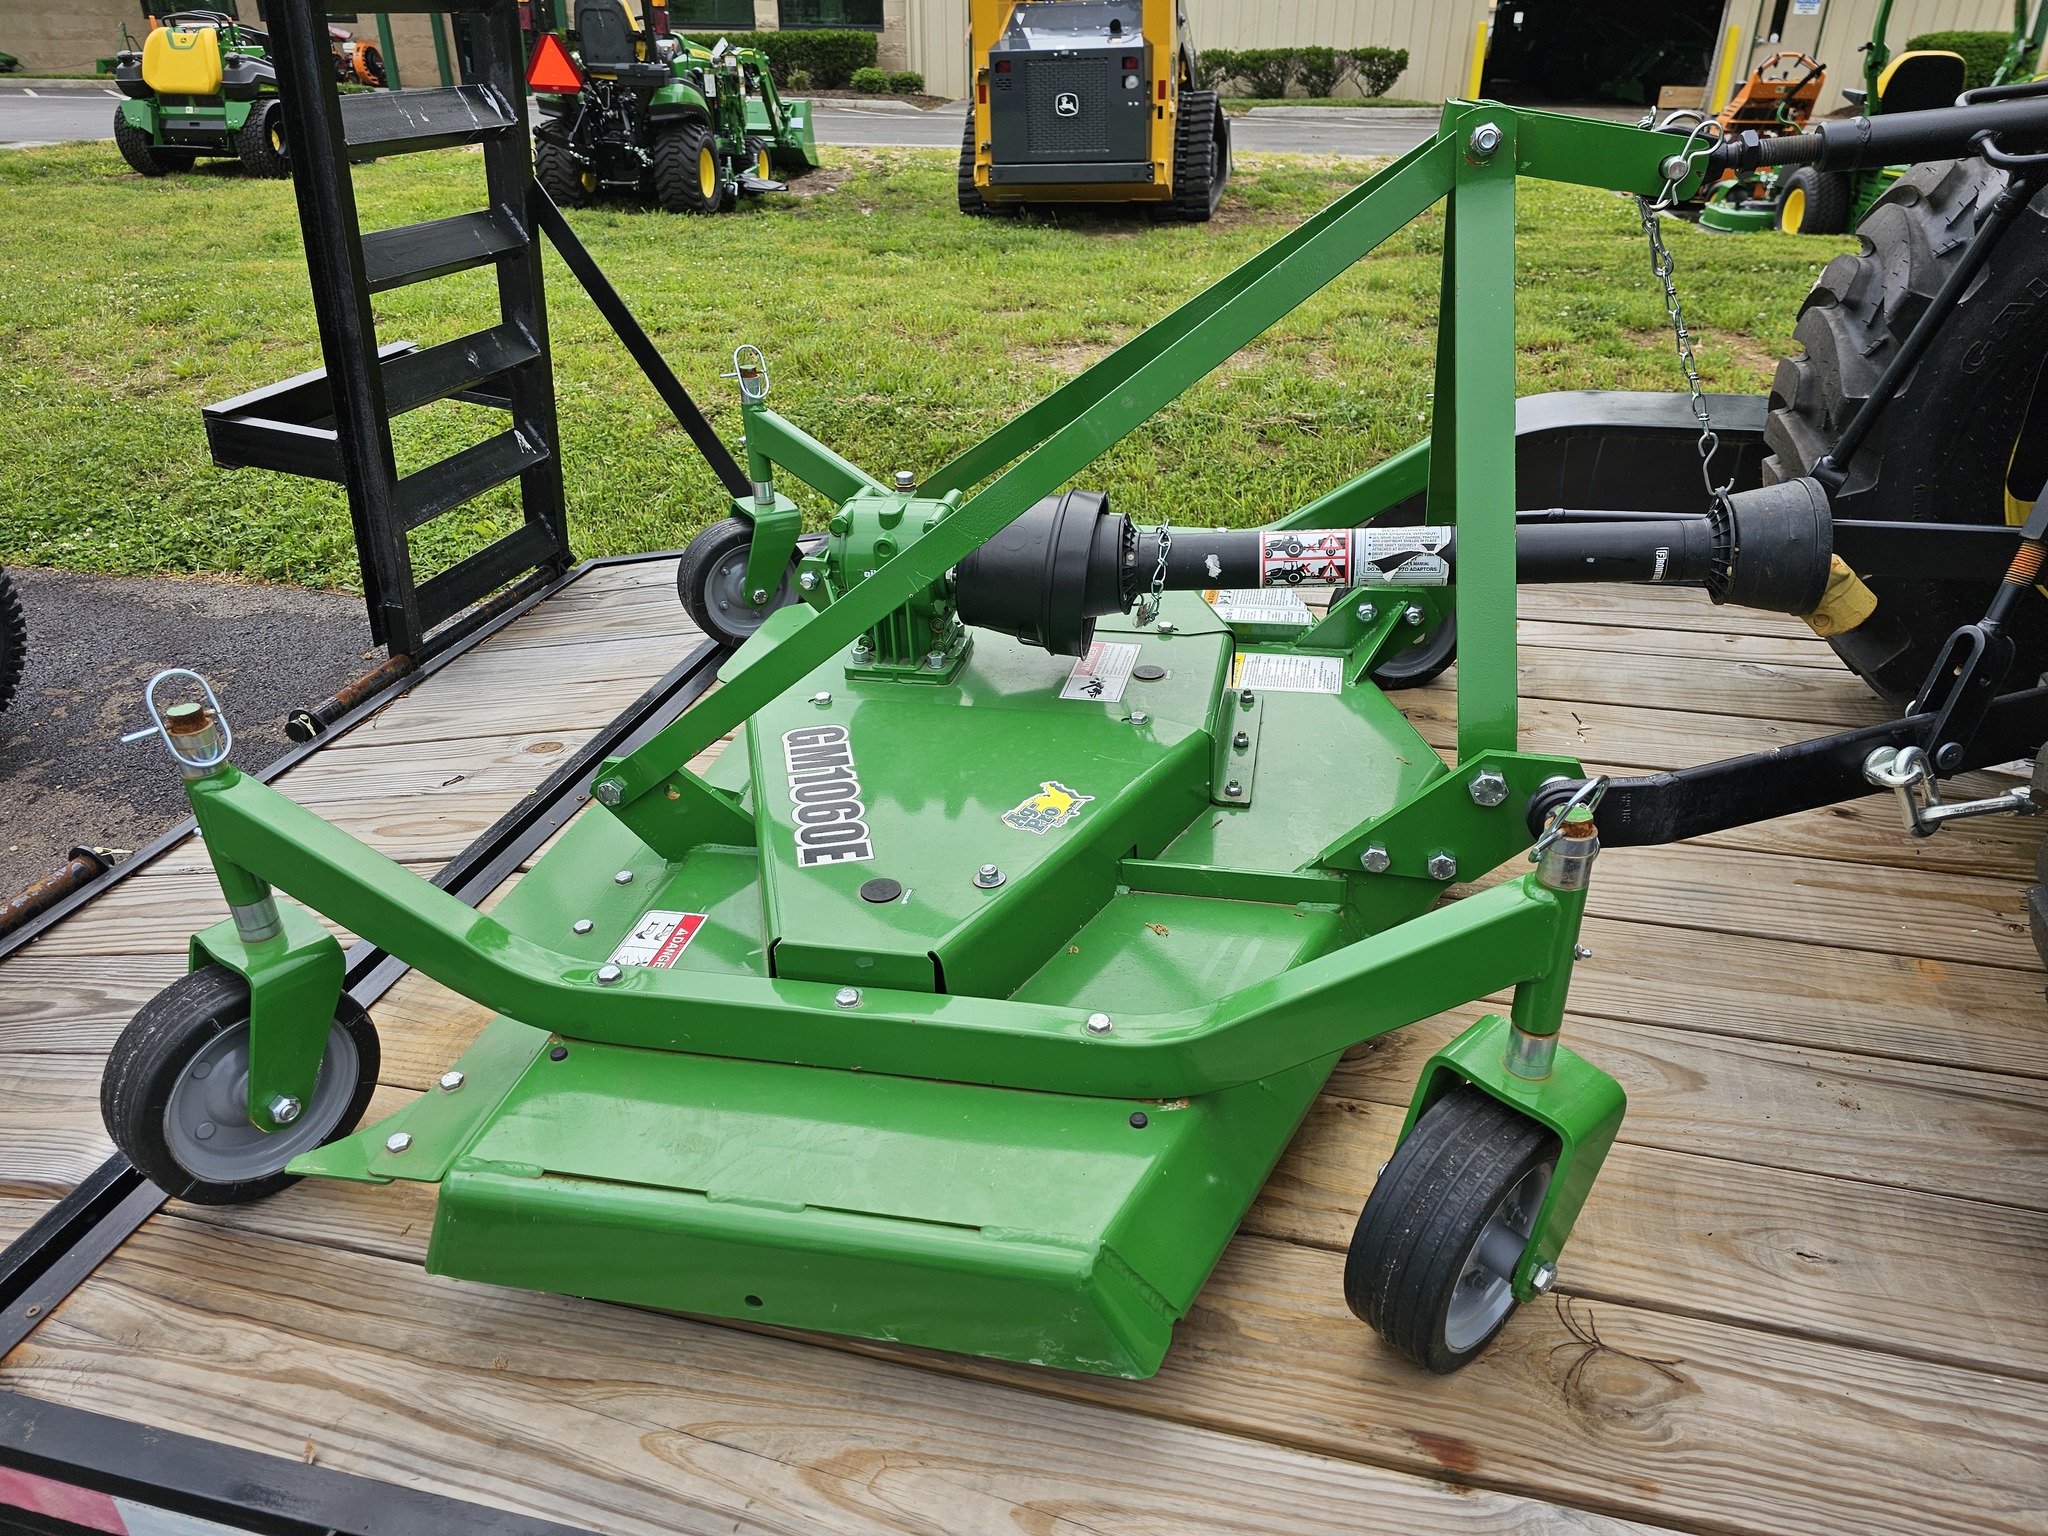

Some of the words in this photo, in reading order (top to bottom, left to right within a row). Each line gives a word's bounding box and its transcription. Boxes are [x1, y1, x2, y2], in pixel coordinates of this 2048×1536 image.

[784, 725, 872, 866] GM1060E
[1004, 802, 1041, 827] Ag-
[1023, 806, 1061, 832] Pro
[653, 936, 684, 968] DANGE
